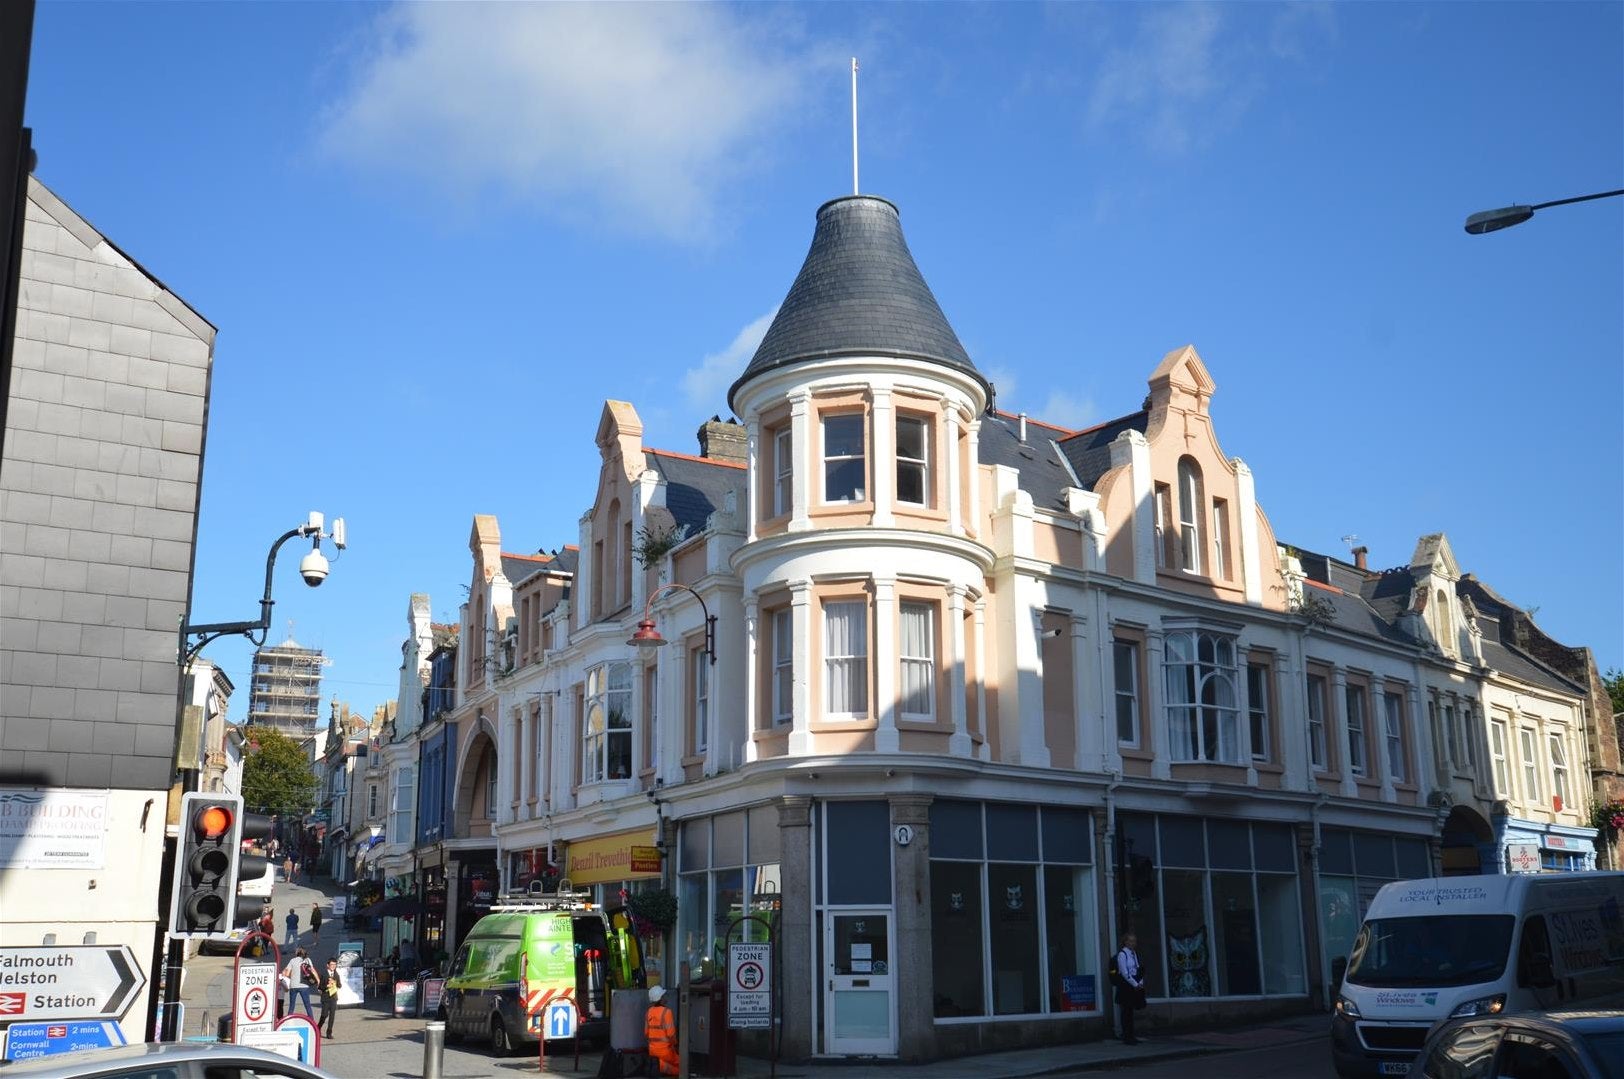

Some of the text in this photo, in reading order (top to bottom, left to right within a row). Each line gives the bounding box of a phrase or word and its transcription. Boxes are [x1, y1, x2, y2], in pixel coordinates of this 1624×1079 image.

[19, 804, 103, 819] BUILDING
[570, 852, 594, 872] Denzil
[1408, 887, 1484, 896] YOUR TRUSTED
[1434, 893, 1487, 901] INSTALLER
[737, 952, 763, 961] ZONE
[242, 967, 274, 975] PEDESTRIAN
[245, 976, 269, 986] ZONE
[33, 994, 96, 1009] Station
[12, 1025, 100, 1038] Station 2 mins
[10, 1040, 50, 1050] Cornwall
[70, 1042, 77, 1051] 2
[15, 1049, 45, 1059] Centre
